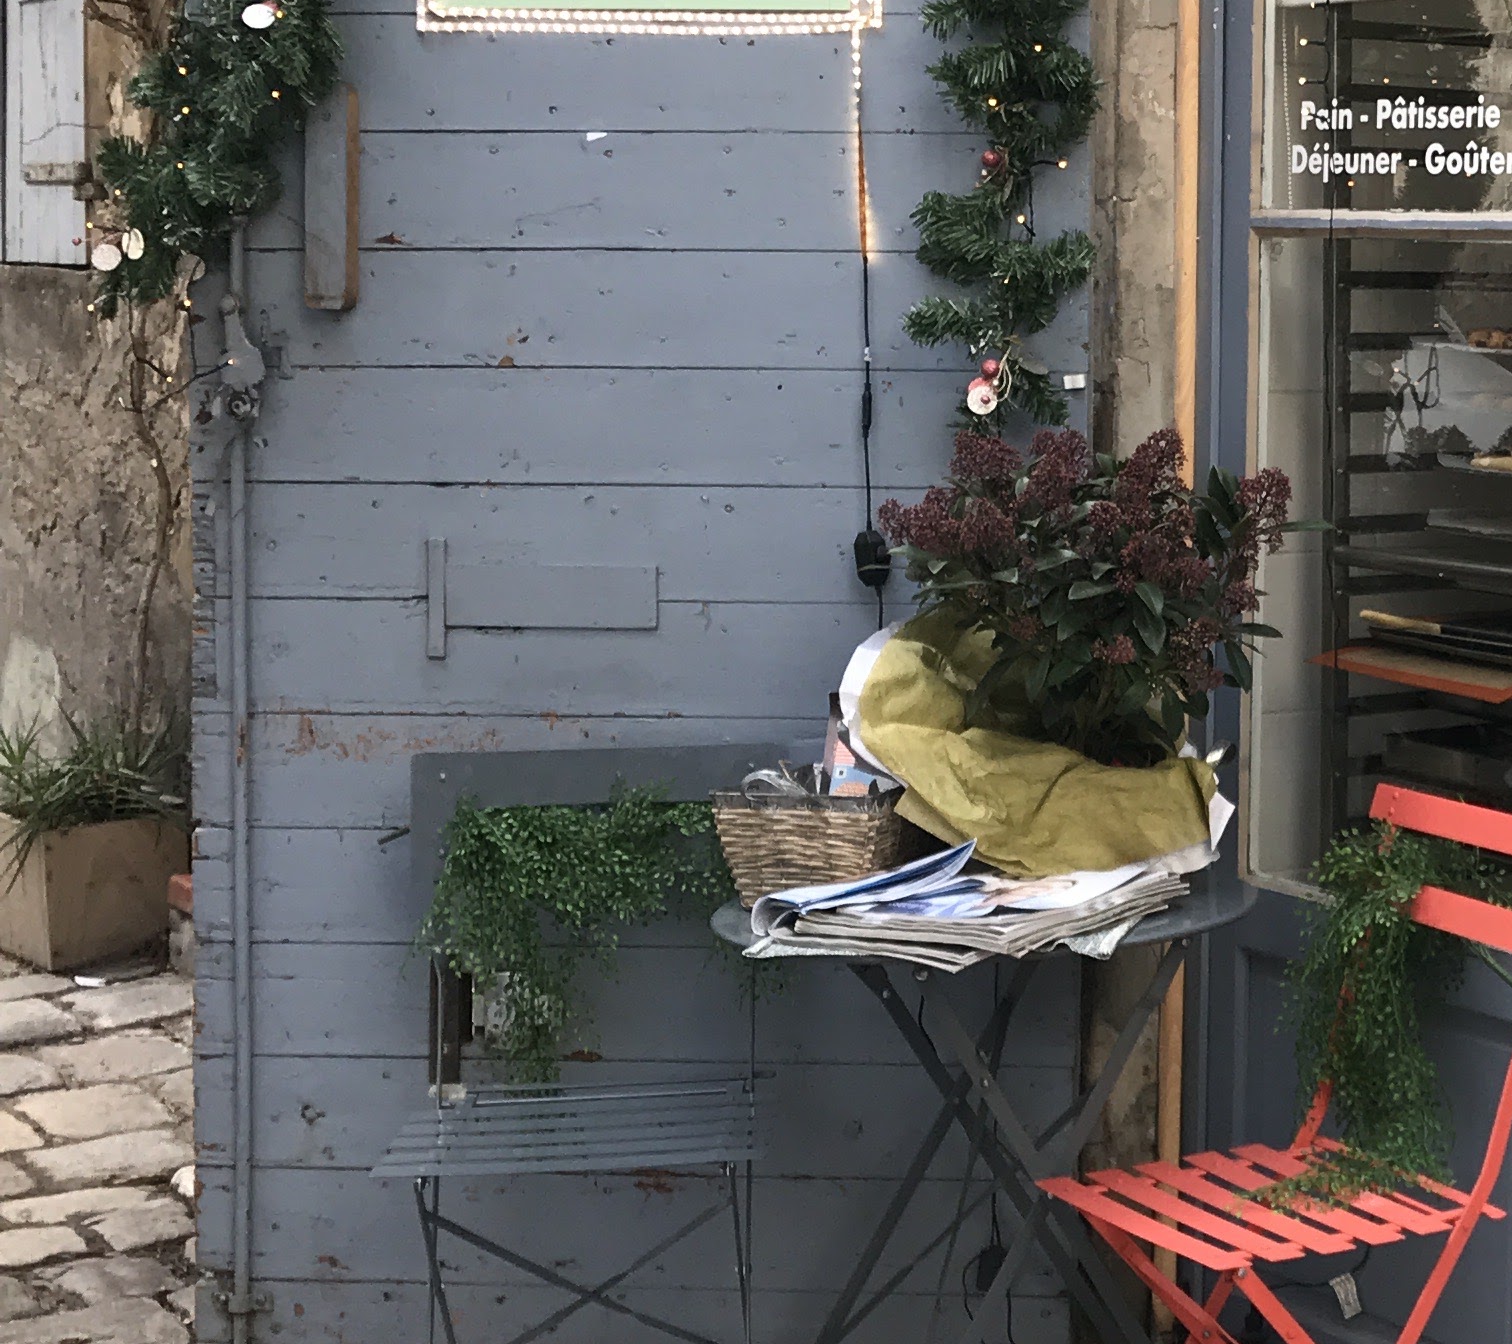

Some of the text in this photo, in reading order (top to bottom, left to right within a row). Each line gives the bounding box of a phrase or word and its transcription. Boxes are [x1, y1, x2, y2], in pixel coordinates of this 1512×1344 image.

[1300, 98, 1353, 131] Pain
[1376, 94, 1501, 130] Pâtisserie
[1292, 142, 1401, 184] Déjeuner
